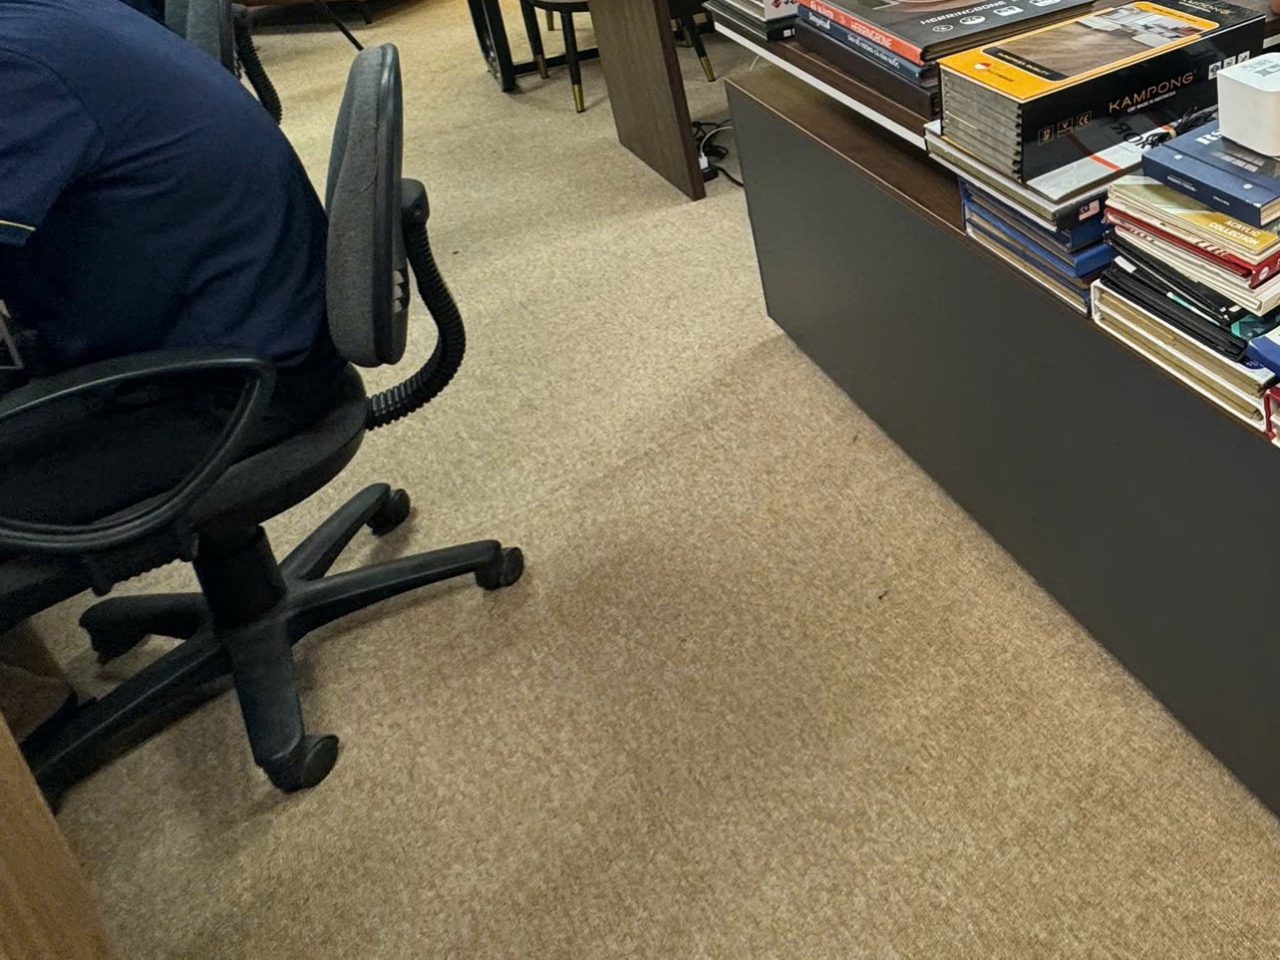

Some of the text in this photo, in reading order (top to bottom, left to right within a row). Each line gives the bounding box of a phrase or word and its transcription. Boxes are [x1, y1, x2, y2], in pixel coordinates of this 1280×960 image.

[920, 0, 1007, 25] HERRINGBONE
[1108, 73, 1195, 113] KAMPONG
[1209, 222, 1259, 245] COLLECTION
[1225, 220, 1262, 238] ACRYLIC
